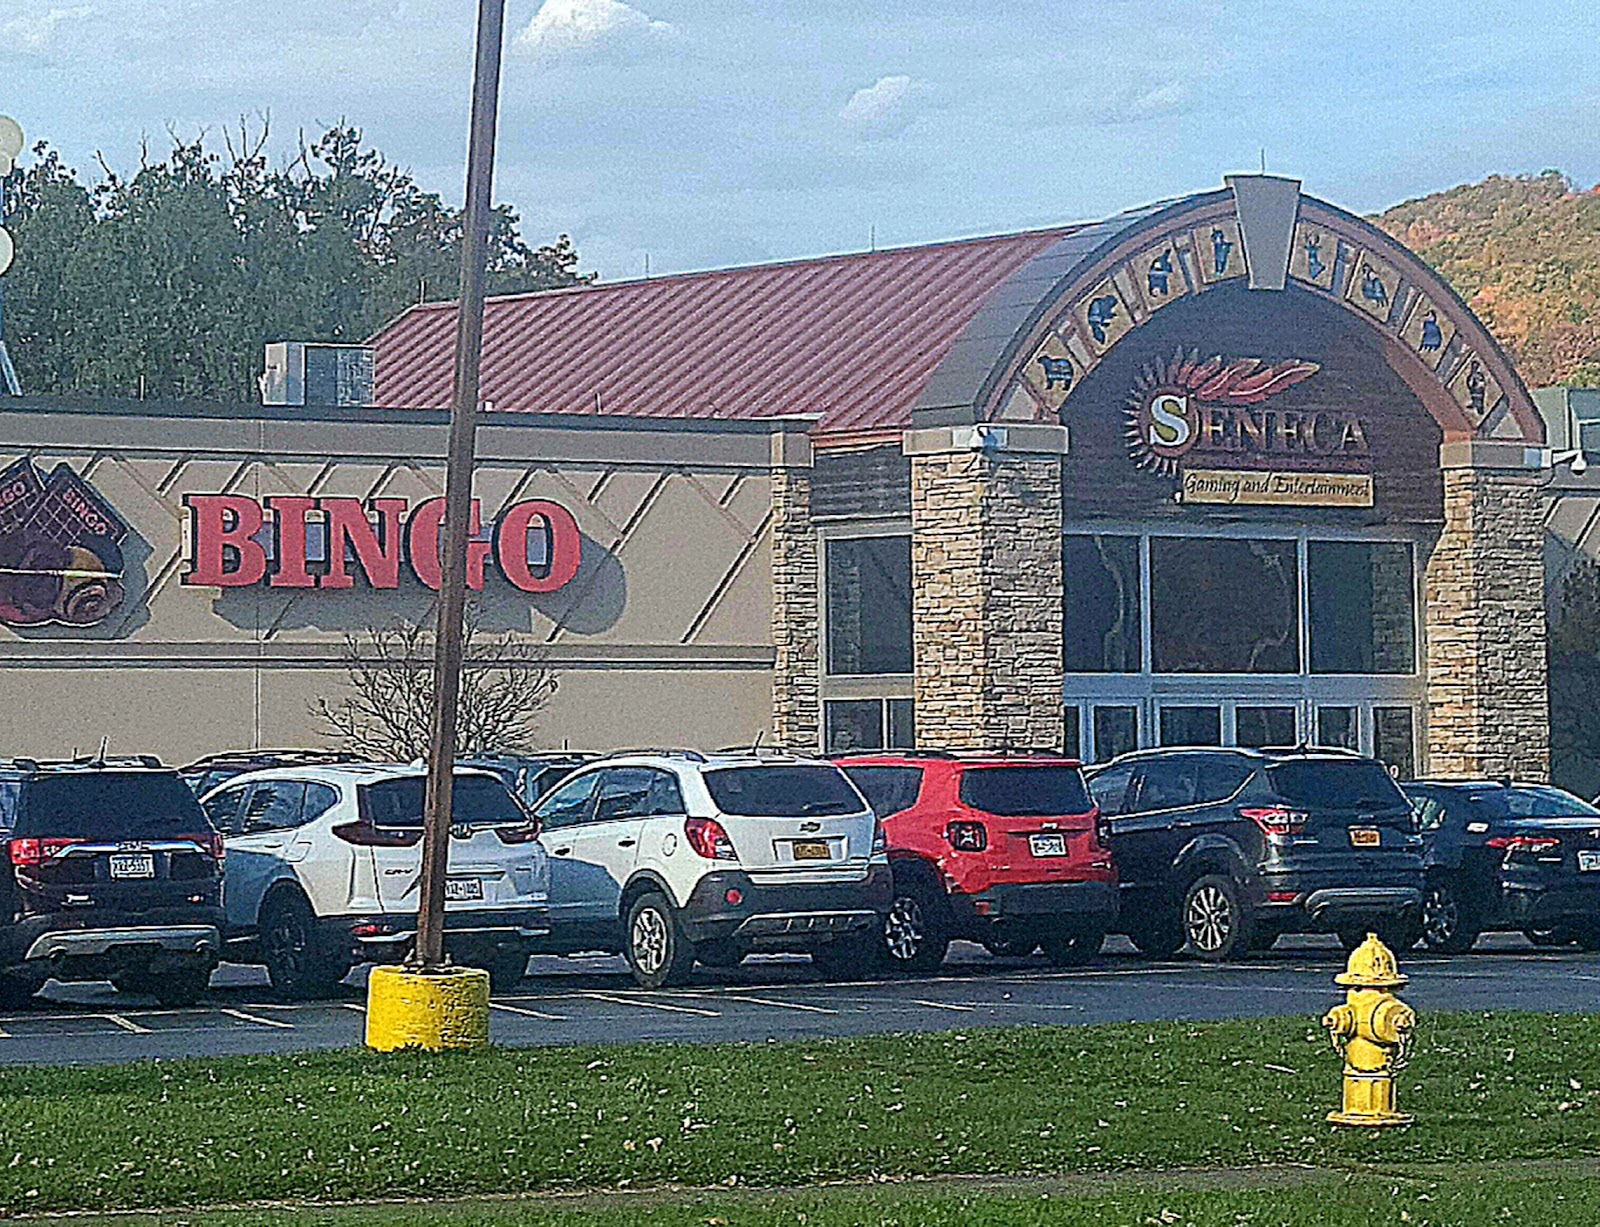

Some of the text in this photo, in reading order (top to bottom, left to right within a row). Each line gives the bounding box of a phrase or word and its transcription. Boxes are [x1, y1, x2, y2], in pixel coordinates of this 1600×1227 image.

[1149, 394, 1370, 452] SENECA
[63, 488, 108, 536] BINGO
[1184, 472, 1371, 502] Gaming and Entertainment
[183, 494, 582, 593] BINGO
